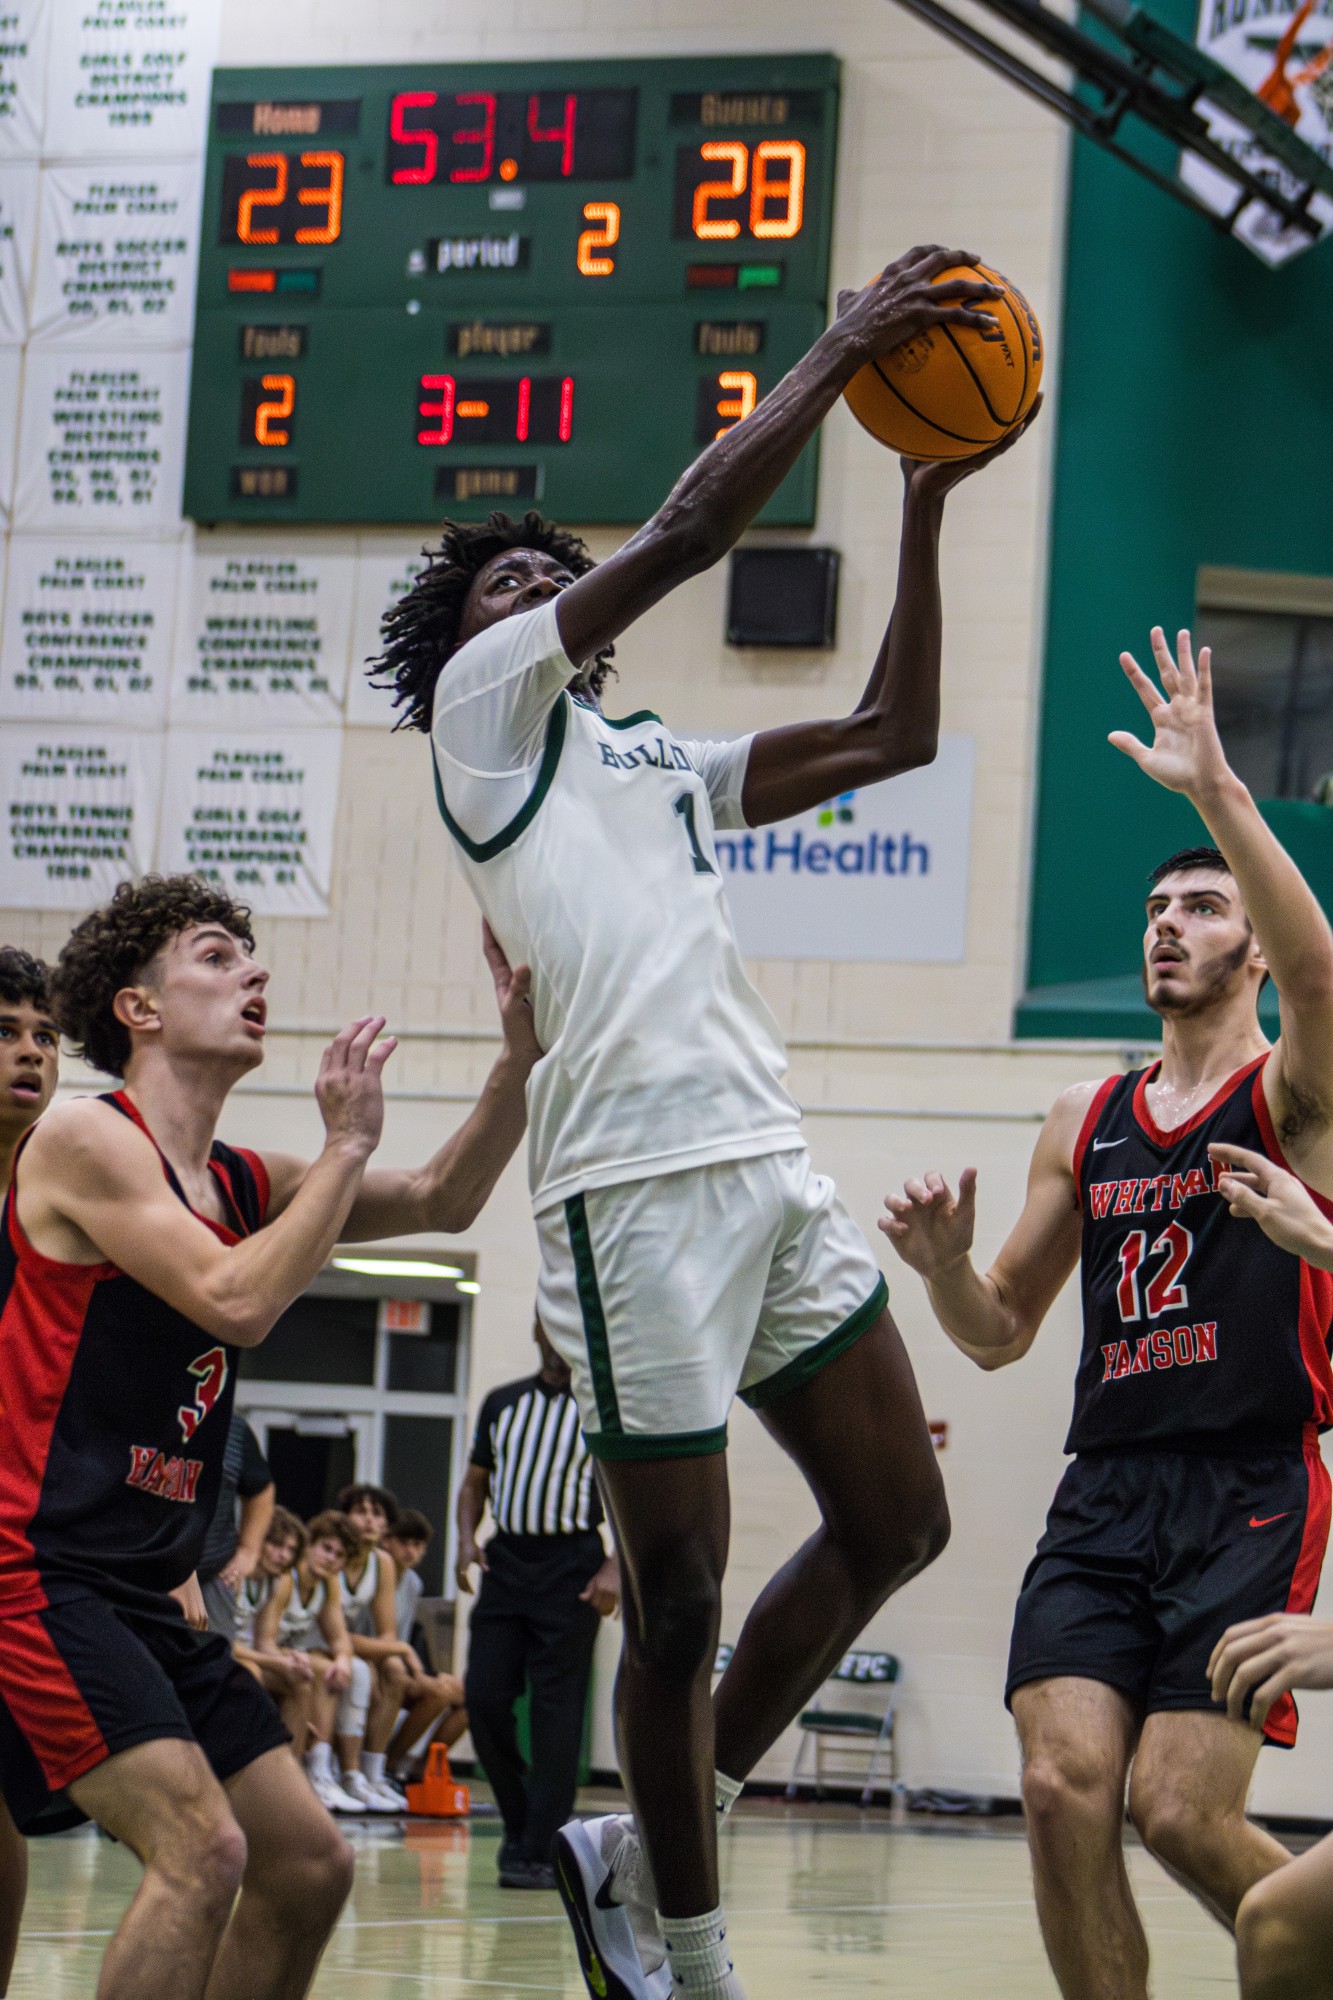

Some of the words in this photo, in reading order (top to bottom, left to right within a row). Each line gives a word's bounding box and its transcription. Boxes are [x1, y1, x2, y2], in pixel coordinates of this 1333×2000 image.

[83, 16, 126, 29] PALM
[135, 16, 187, 29] COAST
[75, 91, 187, 108] CHAMPIONS
[236, 151, 345, 245] 23
[692, 140, 806, 240] 28
[73, 201, 118, 215] PALM
[126, 200, 178, 214] COAST
[115, 237, 187, 254] SOCCER
[576, 202, 621, 276] 2
[436, 230, 520, 273] period
[62, 278, 175, 297] CHAMPIONS
[54, 387, 99, 402] PALM
[107, 387, 160, 402] COAST
[53, 409, 162, 425] WRESTLING
[254, 374, 295, 446] 2
[64, 429, 147, 444] DISTRICT
[48, 449, 160, 466] CHAMPIONS
[39, 575, 85, 590] PALM
[92, 575, 146, 590] COAST
[210, 578, 257, 593] PALM
[264, 578, 318, 593] COAST
[22, 610, 70, 627] BOYS
[82, 611, 154, 628] SOCCER
[206, 616, 318, 632] WRESTLING
[25, 632, 148, 650] CONFERENCE
[198, 637, 322, 653] CONFERENCE
[28, 653, 142, 671] CHAMPIONS
[202, 656, 317, 673] CHAMPIONS
[22, 763, 67, 778] PALM
[74, 763, 128, 778] COAST
[197, 767, 243, 783] PALM
[252, 768, 304, 784] COAST
[10, 802, 58, 820] BOYS
[68, 804, 134, 822] TENNIS
[193, 807, 248, 825] GIRLS
[257, 808, 302, 825] GOLF
[11, 823, 131, 842] CONFERENCE
[184, 827, 308, 845] CONFERENCE
[671, 789, 720, 878] 1
[13, 843, 126, 861] CHAMPIONS
[187, 848, 303, 866] CHAMPIONS
[1117, 1219, 1194, 1323] 12
